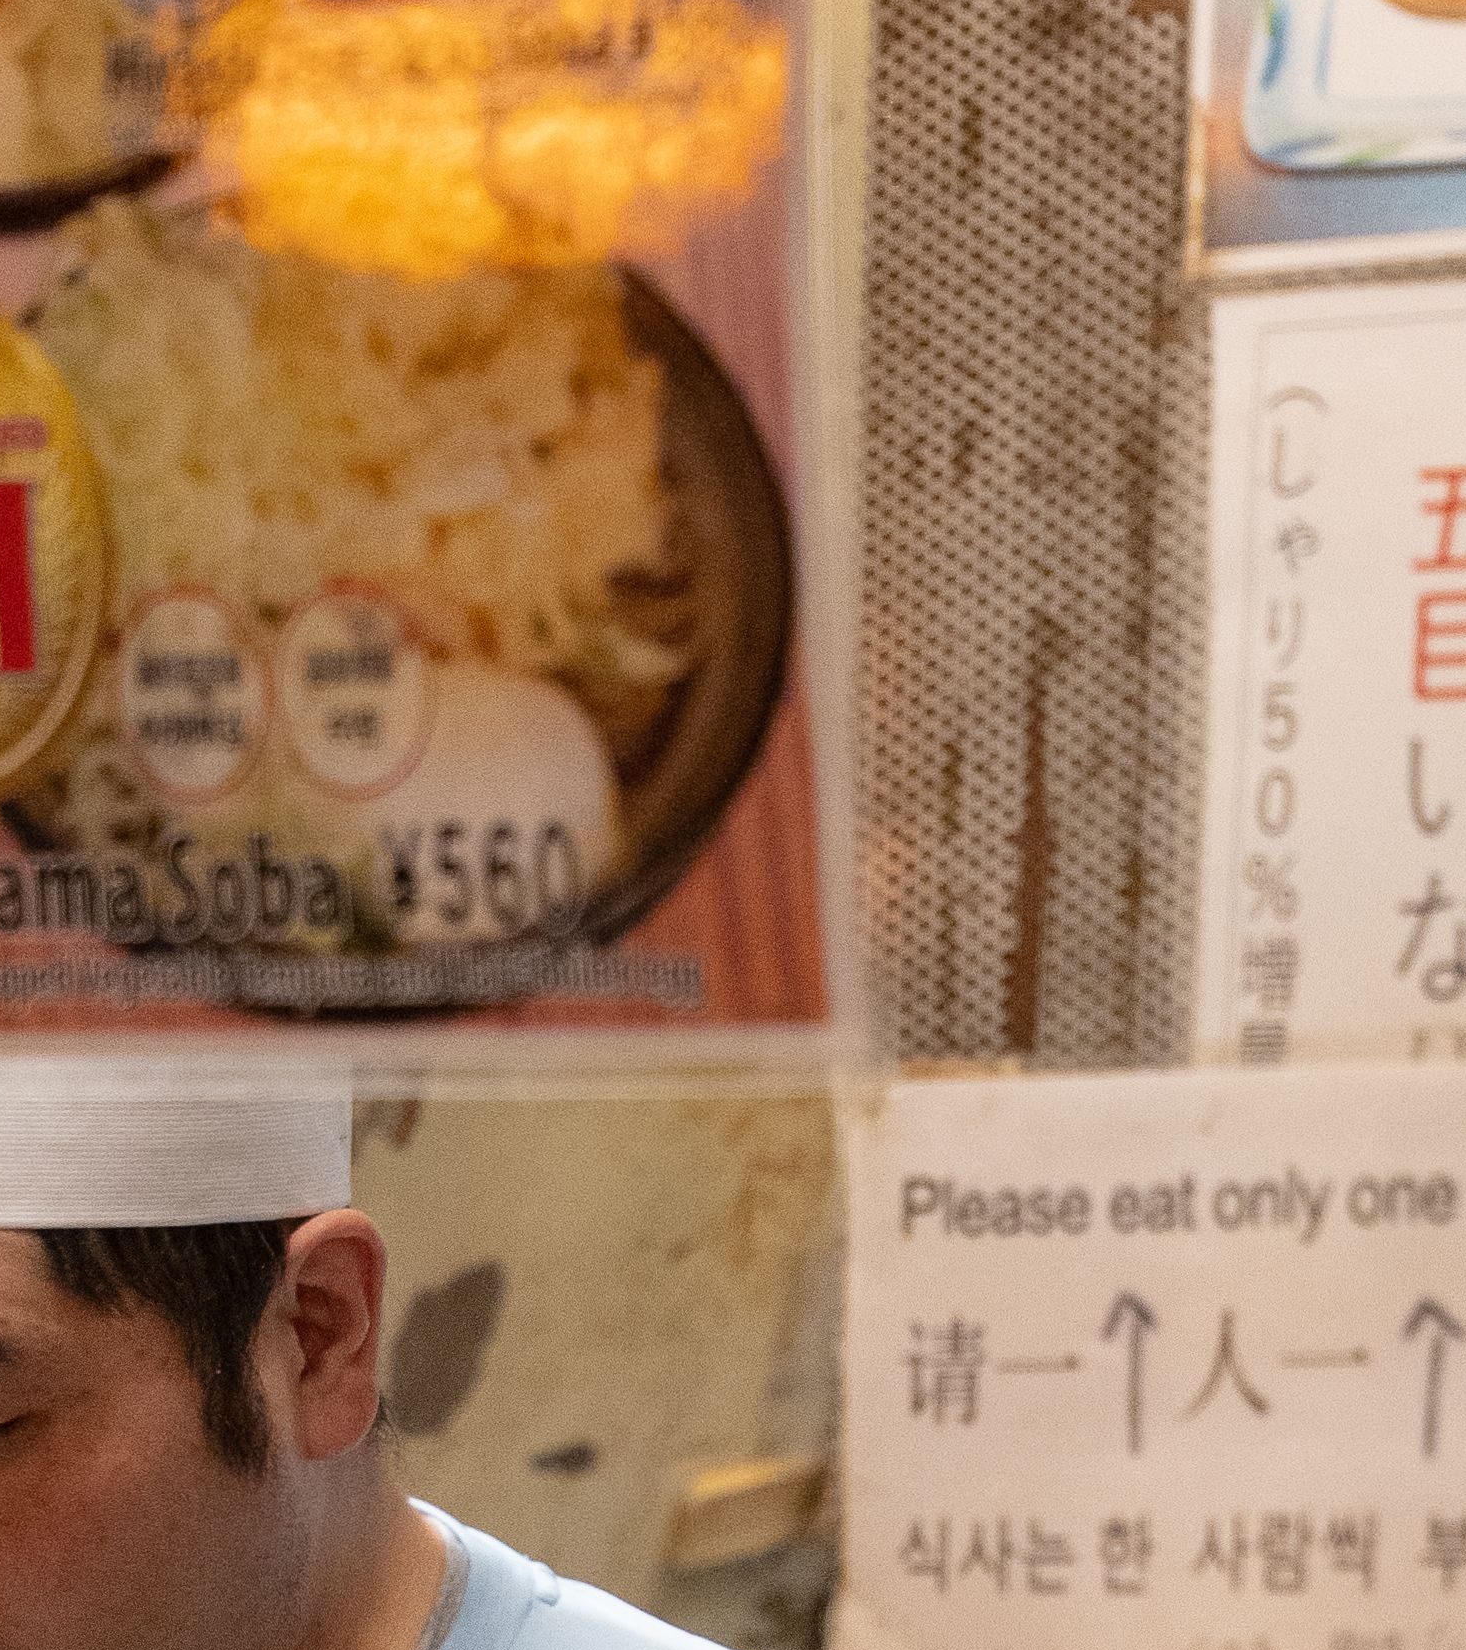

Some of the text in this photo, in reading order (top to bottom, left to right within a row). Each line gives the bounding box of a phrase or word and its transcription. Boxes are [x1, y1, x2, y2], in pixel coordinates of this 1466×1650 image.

[163, 828, 352, 942] Soba
[378, 814, 585, 935] ¥560
[900, 1173, 1091, 1240] Please
[1108, 1174, 1198, 1232] eat
[1212, 1165, 1332, 1244] only
[1347, 1176, 1457, 1227] one
